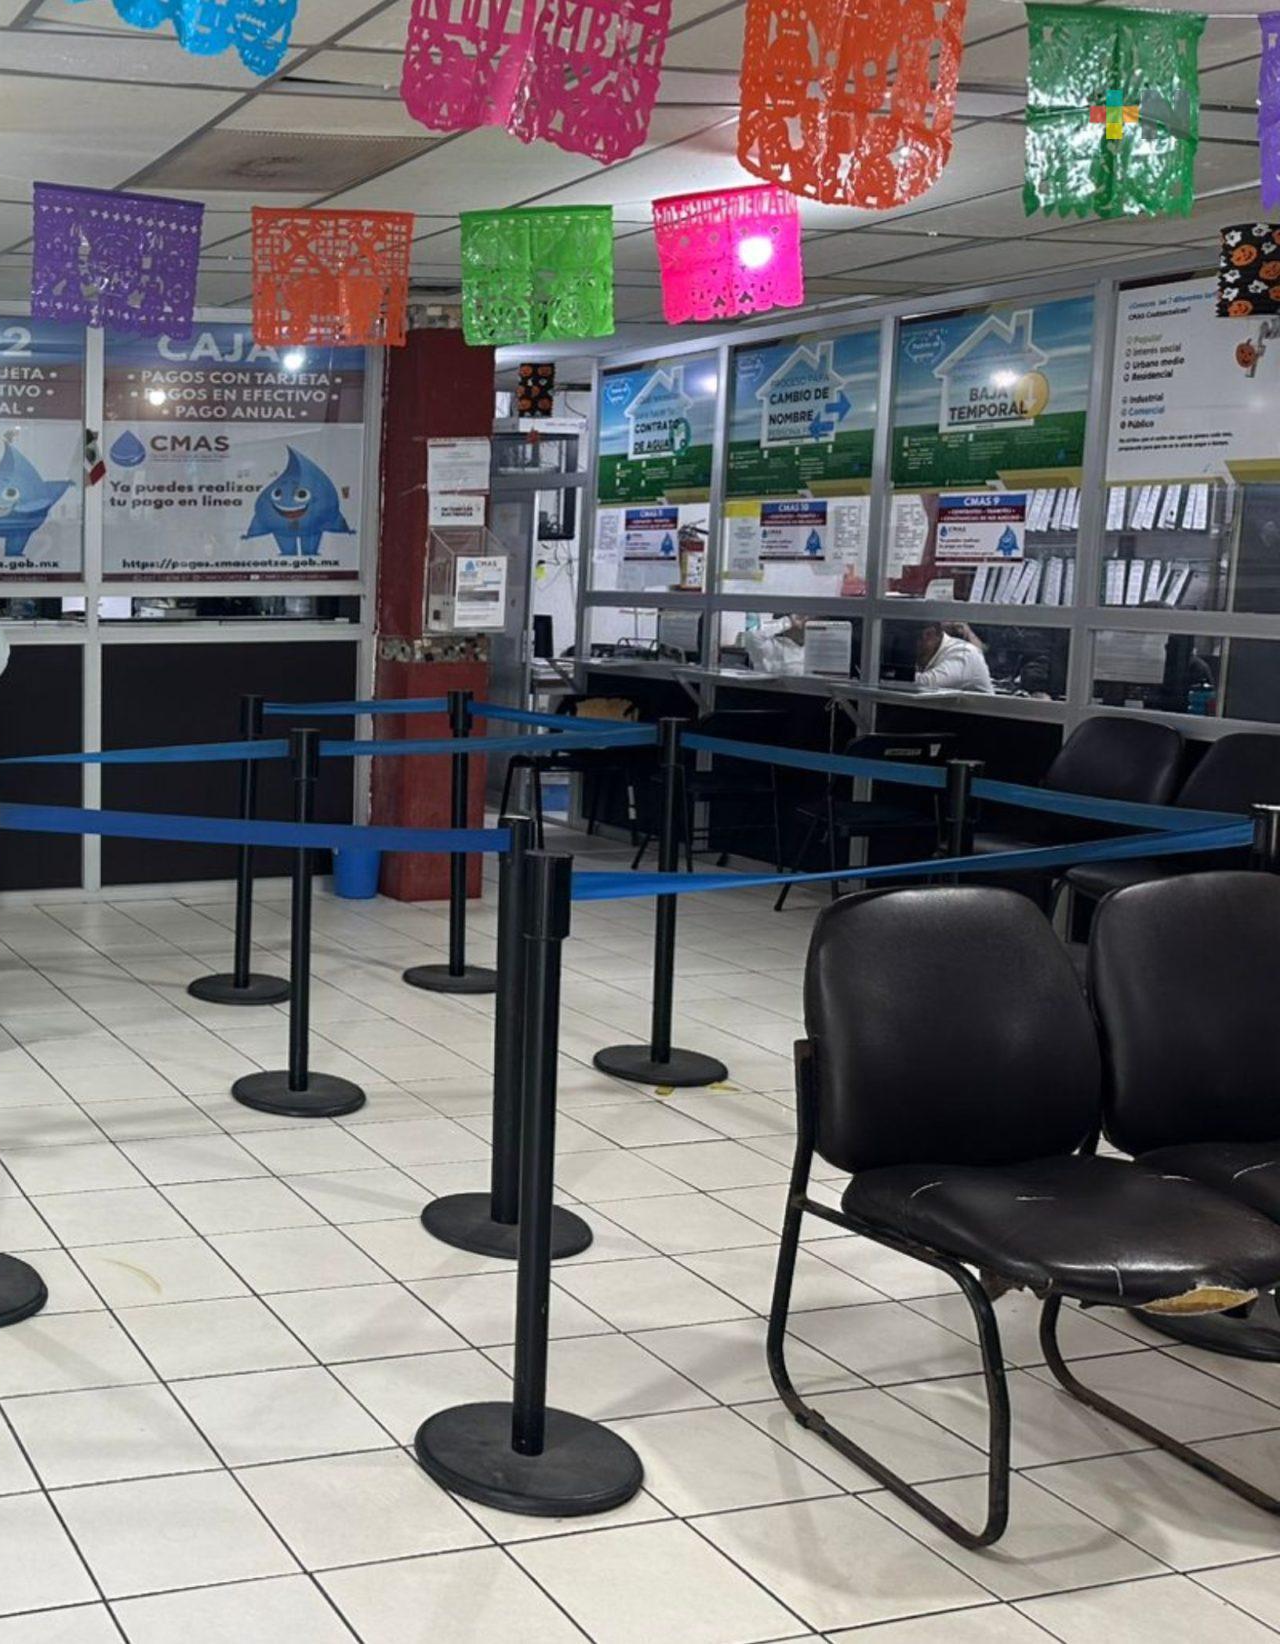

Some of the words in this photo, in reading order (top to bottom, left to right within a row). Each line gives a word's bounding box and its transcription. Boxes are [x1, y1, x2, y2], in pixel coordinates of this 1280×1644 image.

[3, 326, 32, 356] 2
[157, 332, 280, 363] CAJA
[1132, 360, 1159, 369] Urbano
[141, 371, 205, 384] PAGOS
[209, 372, 250, 384] CON
[254, 373, 330, 386] TARJETA
[1132, 368, 1173, 380] Residencial
[213, 389, 237, 401] EN
[243, 390, 326, 402] EFECTIVO
[770, 389, 812, 405] CAMBIO
[814, 387, 829, 400] DE
[969, 387, 1008, 401] BAJA
[1130, 392, 1164, 404] Industrial
[175, 406, 227, 418] PAGO
[232, 406, 295, 419] ANUAL
[769, 409, 814, 425] NOMBRE
[949, 400, 1028, 421] TEMPORAL
[1128, 406, 1165, 416] Comercial
[635, 419, 679, 434] CONTRATO
[150, 435, 230, 452] CMAS
[634, 440, 645, 453] DE
[110, 481, 130, 492] Ya
[135, 481, 194, 495] puedes
[198, 481, 263, 493] realizar
[110, 496, 127, 507] tu
[132, 498, 174, 509] pago
[178, 498, 197, 507] en
[778, 503, 799, 511] CMAS
[963, 497, 992, 506] CMAS
[993, 496, 1000, 505] 9
